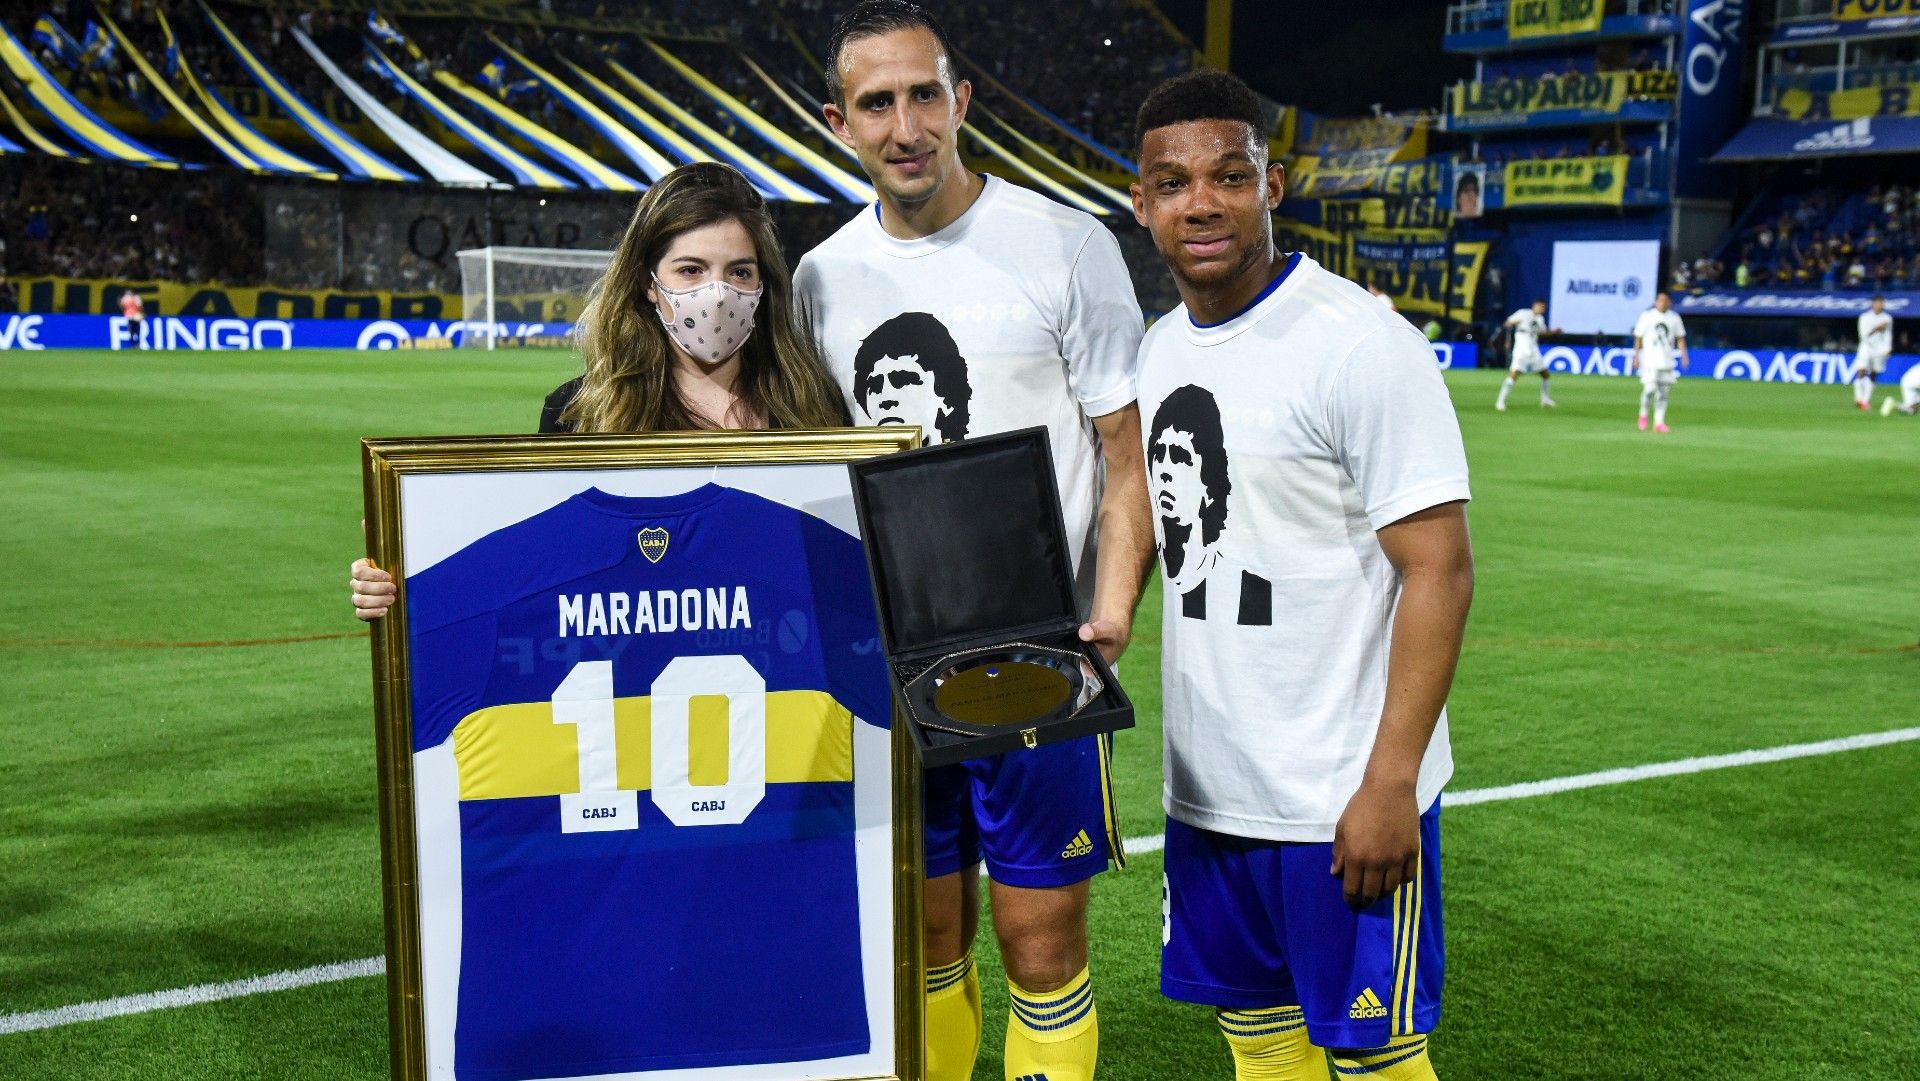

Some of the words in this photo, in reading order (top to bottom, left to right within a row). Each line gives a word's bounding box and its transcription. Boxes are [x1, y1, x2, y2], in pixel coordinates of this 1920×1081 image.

[1567, 279, 1618, 295] Allianz
[1764, 351, 1862, 384] ACTIV
[642, 539, 665, 547] CABJ
[558, 586, 751, 637] MARADONA
[551, 654, 766, 834] 10
[582, 806, 617, 819] CABJ
[691, 800, 726, 812] CABJ
[1061, 844, 1094, 859] adida
[1349, 1007, 1388, 1019] adidas
